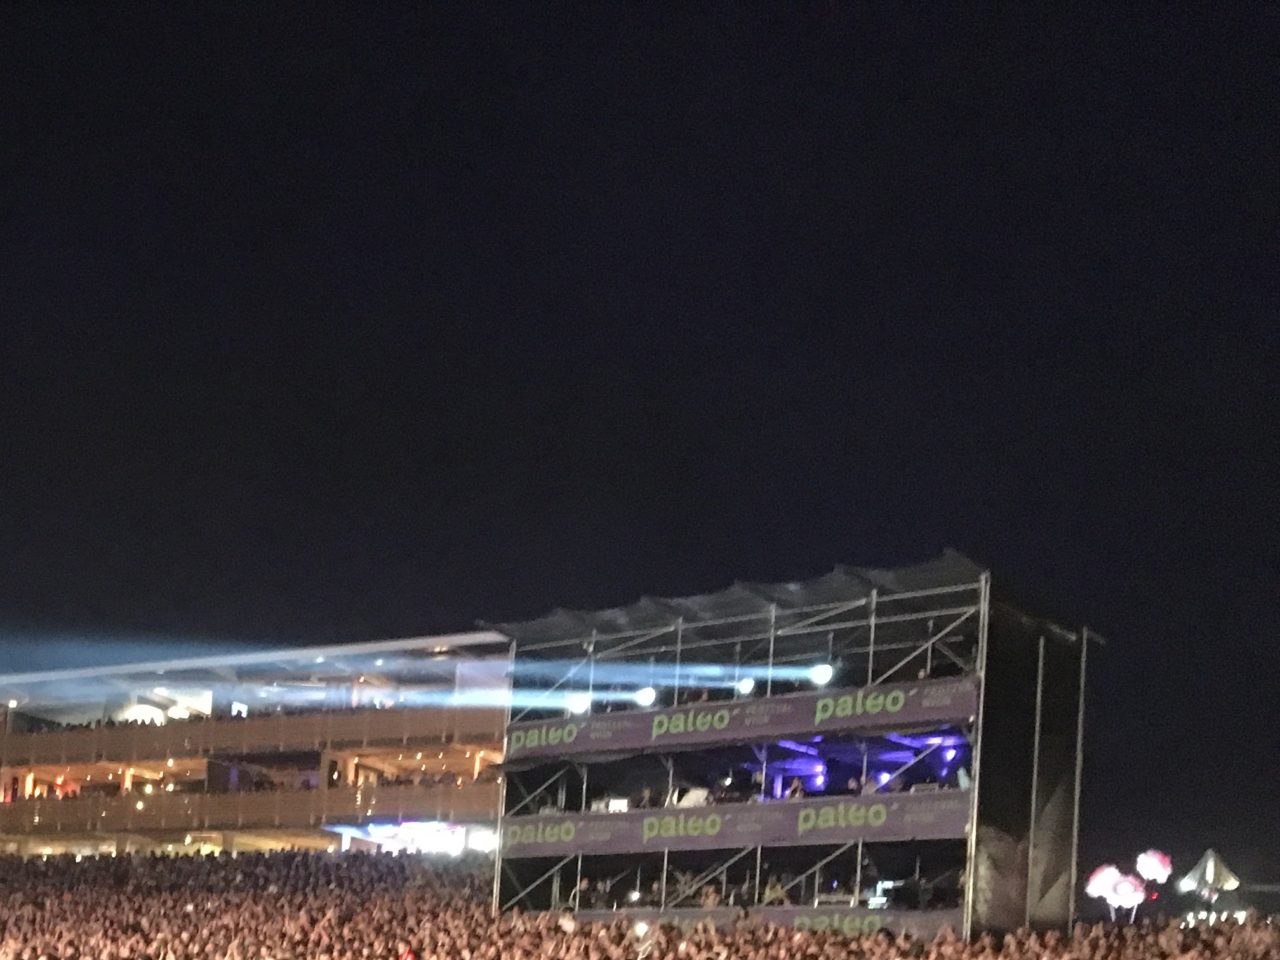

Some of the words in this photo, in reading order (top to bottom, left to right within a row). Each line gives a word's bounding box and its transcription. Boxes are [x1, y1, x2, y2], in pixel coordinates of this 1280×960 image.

[815, 689, 905, 727] paleo
[652, 709, 730, 741] paleo
[643, 813, 721, 844] paleo
[798, 802, 887, 836] paleo
